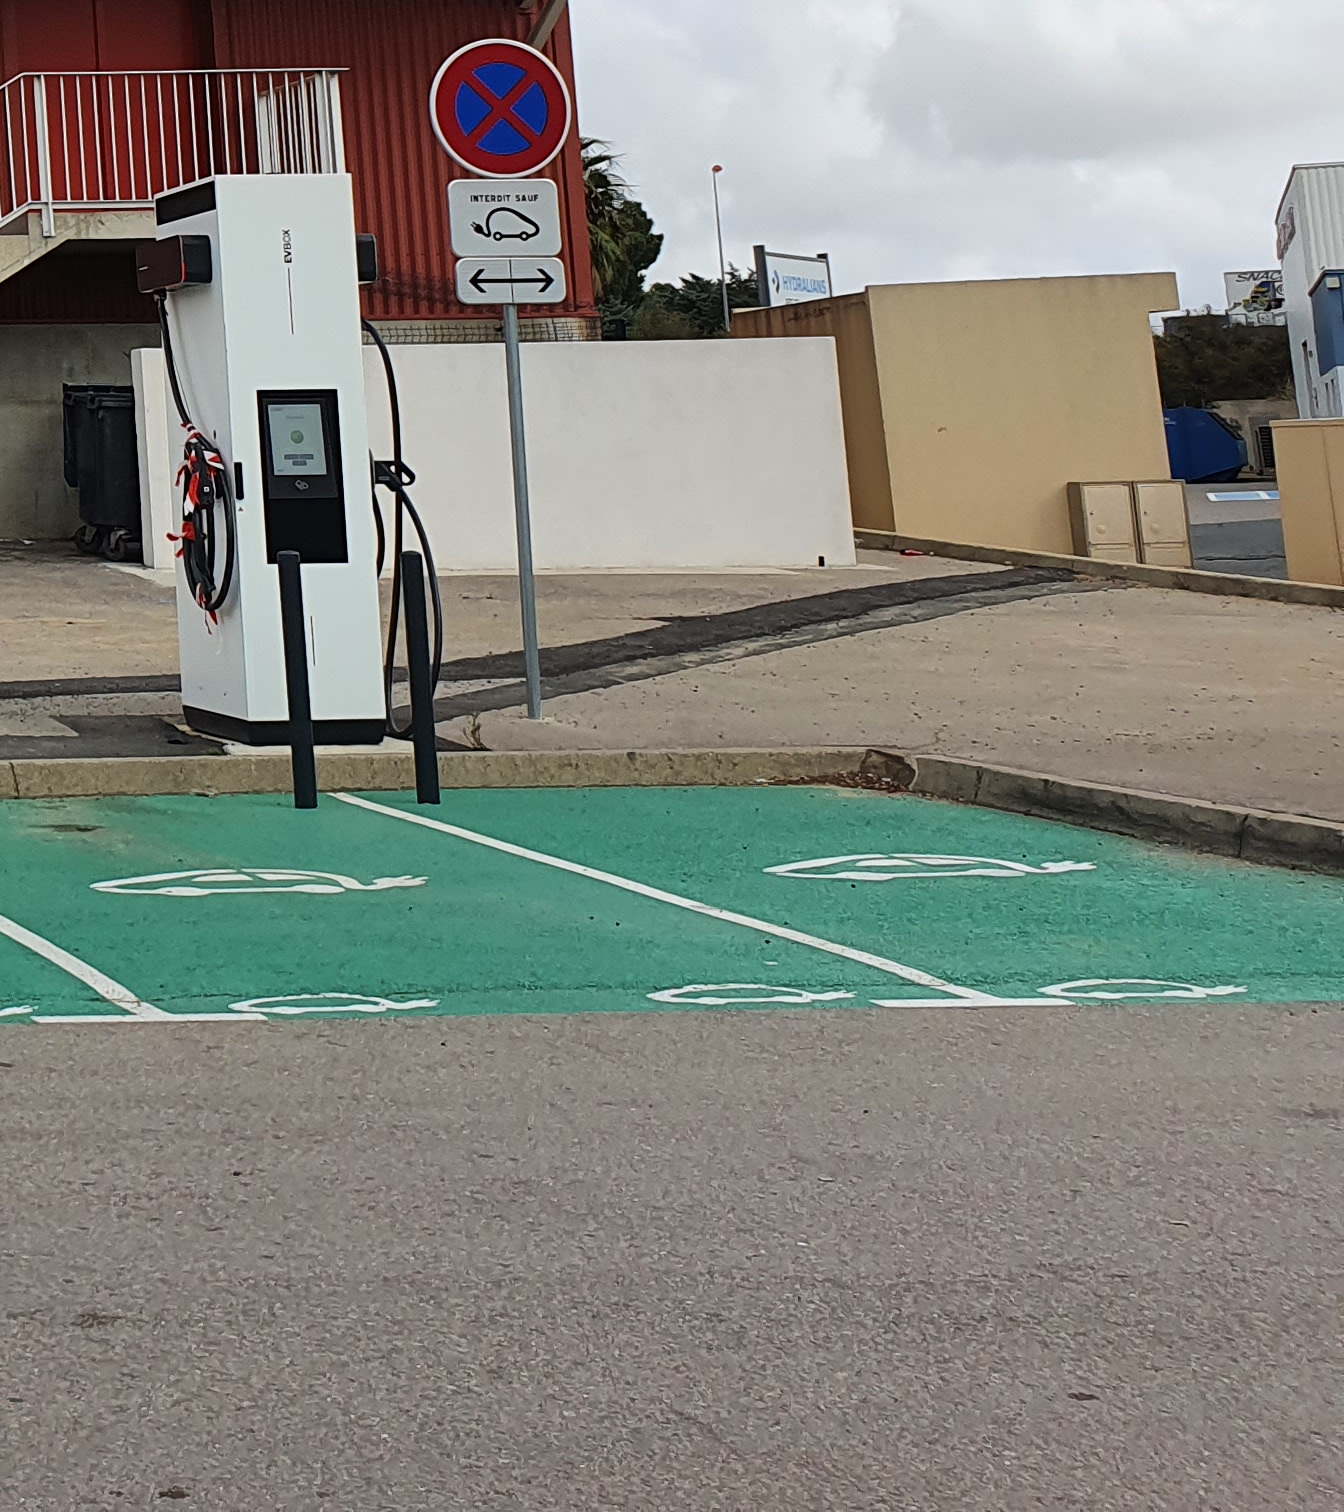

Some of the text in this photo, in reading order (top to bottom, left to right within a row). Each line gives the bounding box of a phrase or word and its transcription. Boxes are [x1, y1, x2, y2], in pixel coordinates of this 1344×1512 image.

[470, 193, 539, 203] INTERDIT SAUF
[282, 229, 292, 263] EVBOX
[1236, 271, 1283, 282] SNAC
